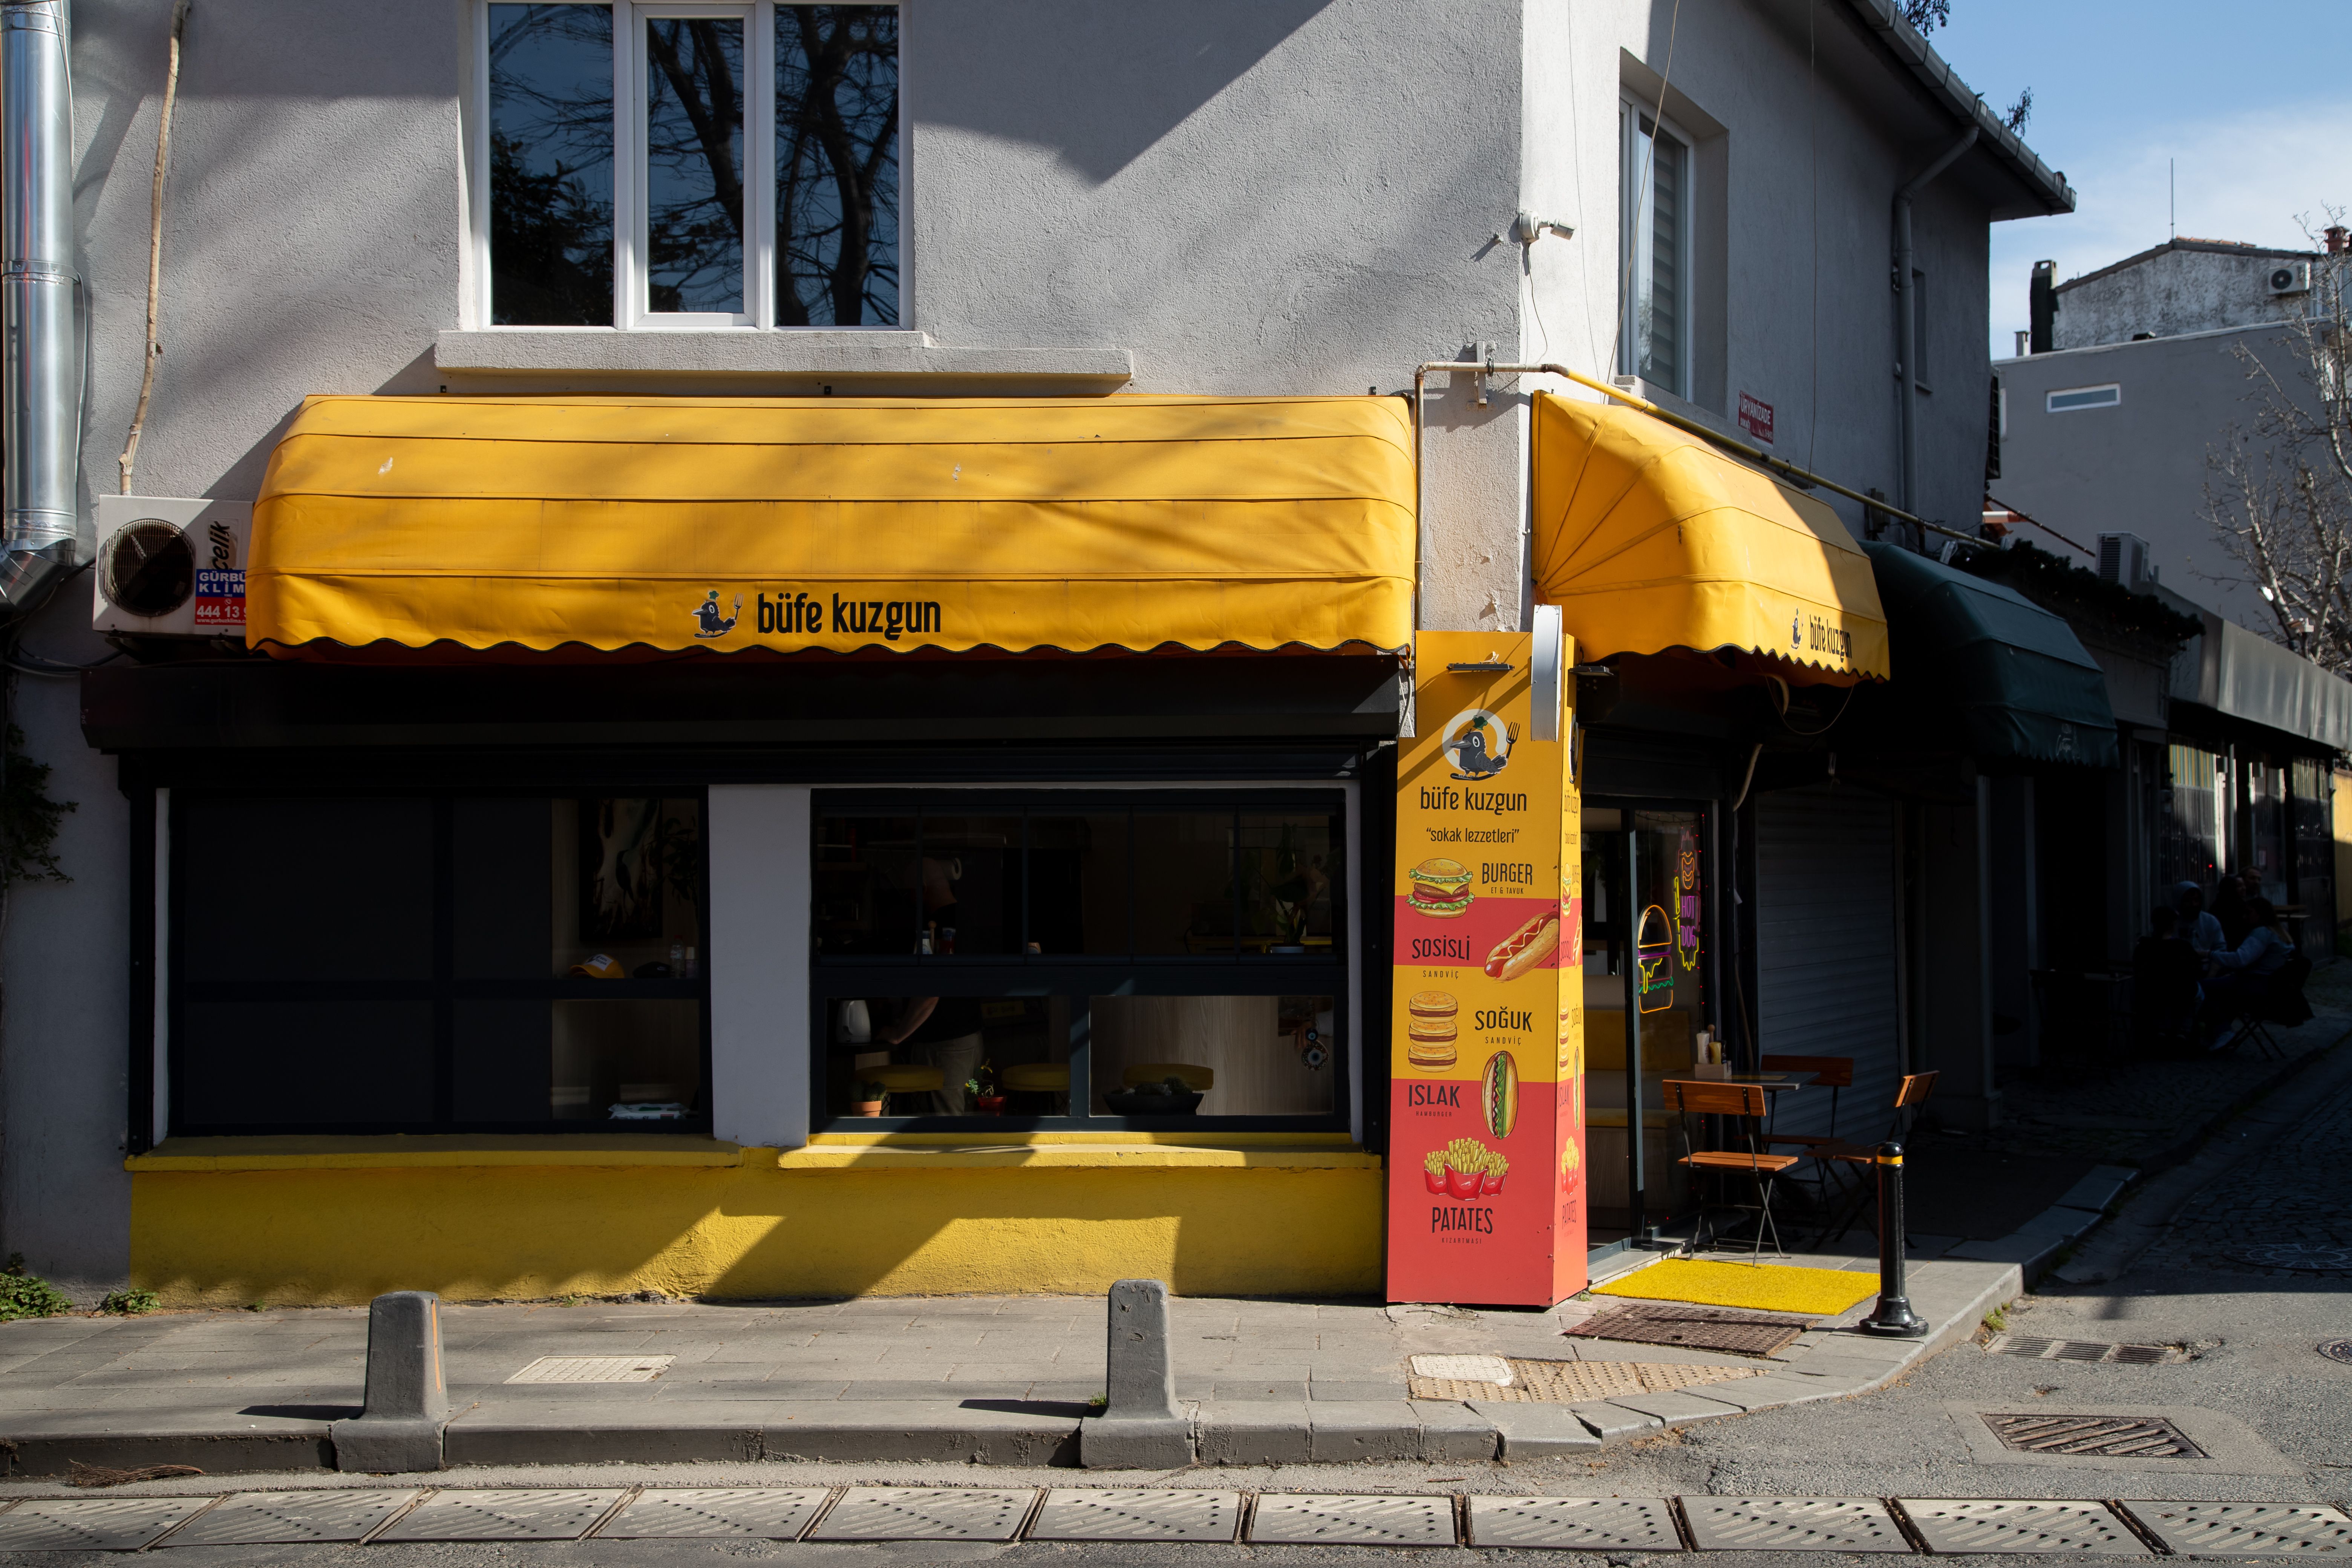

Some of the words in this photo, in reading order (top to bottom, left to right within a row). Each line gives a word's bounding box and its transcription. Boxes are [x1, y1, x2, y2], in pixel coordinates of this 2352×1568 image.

[1740, 394, 1771, 425] ÜRYANİZADE
[197, 605, 220, 617] 444
[225, 606, 240, 618] 13
[758, 593, 822, 634] büfe
[833, 592, 941, 641] kuzgun
[1809, 614, 1826, 652] büfe
[1827, 619, 1852, 663] kuzgun
[1421, 786, 1459, 810] büfe
[1465, 787, 1527, 815] kuzgun
[1482, 863, 1533, 886] BURGER
[1681, 896, 1695, 919] HOT
[1412, 935, 1470, 961] SOSİSLİ
[1680, 925, 1696, 947] DOG
[1423, 969, 1459, 980] SANDVİÇ
[1475, 1006, 1533, 1033] SOĞUK
[1485, 1036, 1521, 1046] SANDVİÇ
[1409, 1084, 1461, 1109] ISLAK
[1558, 1084, 1570, 1110] ISLAK
[1432, 1207, 1493, 1234] PATATES
[1562, 1199, 1576, 1230] PATATES
